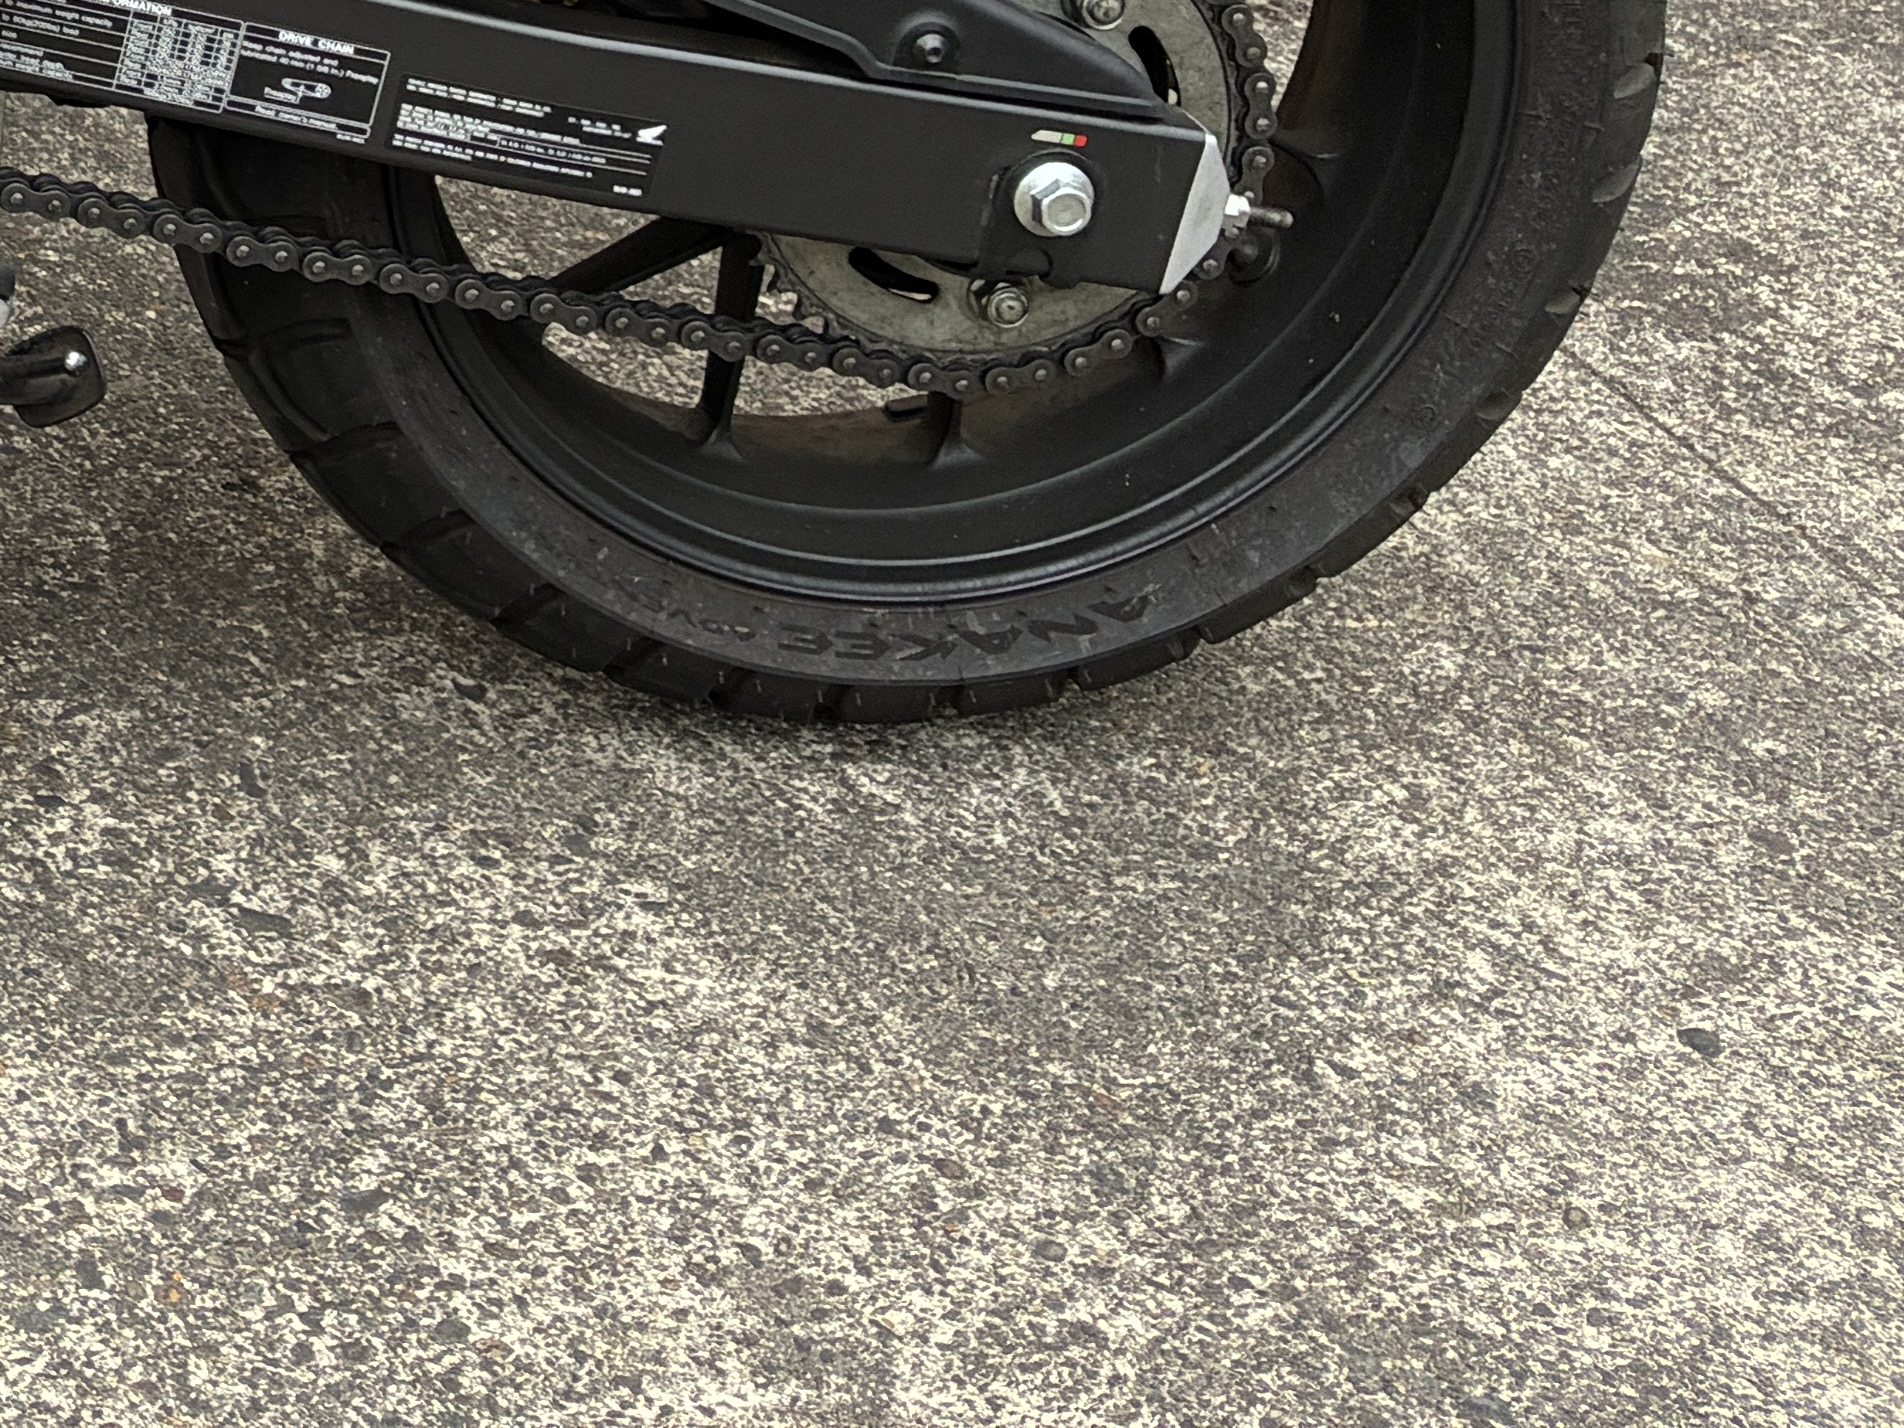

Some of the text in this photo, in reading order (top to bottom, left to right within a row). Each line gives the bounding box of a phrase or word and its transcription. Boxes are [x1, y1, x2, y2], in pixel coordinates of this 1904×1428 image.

[278, 30, 355, 55] DRIVE CHAIN
[778, 594, 1158, 665] ANAKEE
